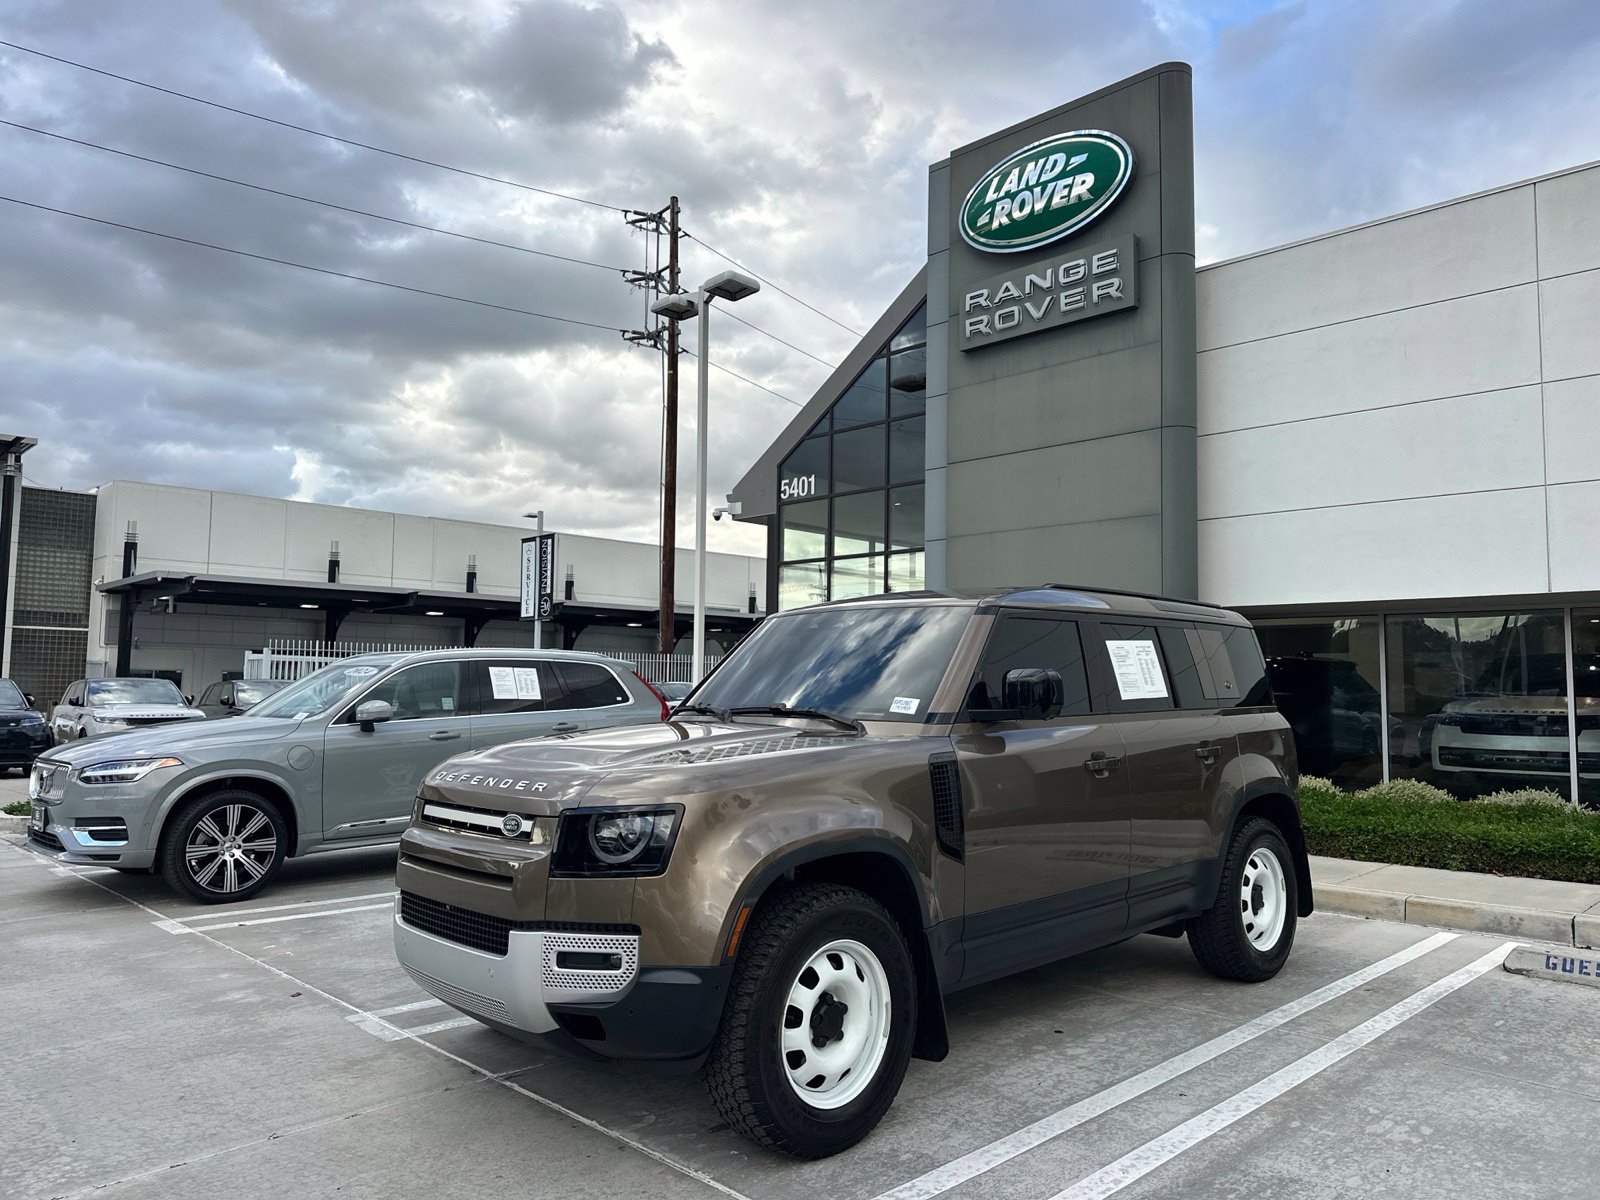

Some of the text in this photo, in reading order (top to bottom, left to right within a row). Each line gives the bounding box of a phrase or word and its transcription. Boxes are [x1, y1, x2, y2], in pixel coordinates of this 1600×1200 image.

[984, 152, 1067, 204] LAND
[991, 172, 1095, 231] ROVER
[965, 248, 1120, 313] RANGE
[965, 277, 1125, 339] ROVER
[780, 474, 815, 499] 5401
[541, 539, 549, 595] ENVISION
[435, 771, 548, 792] DEFENDER
